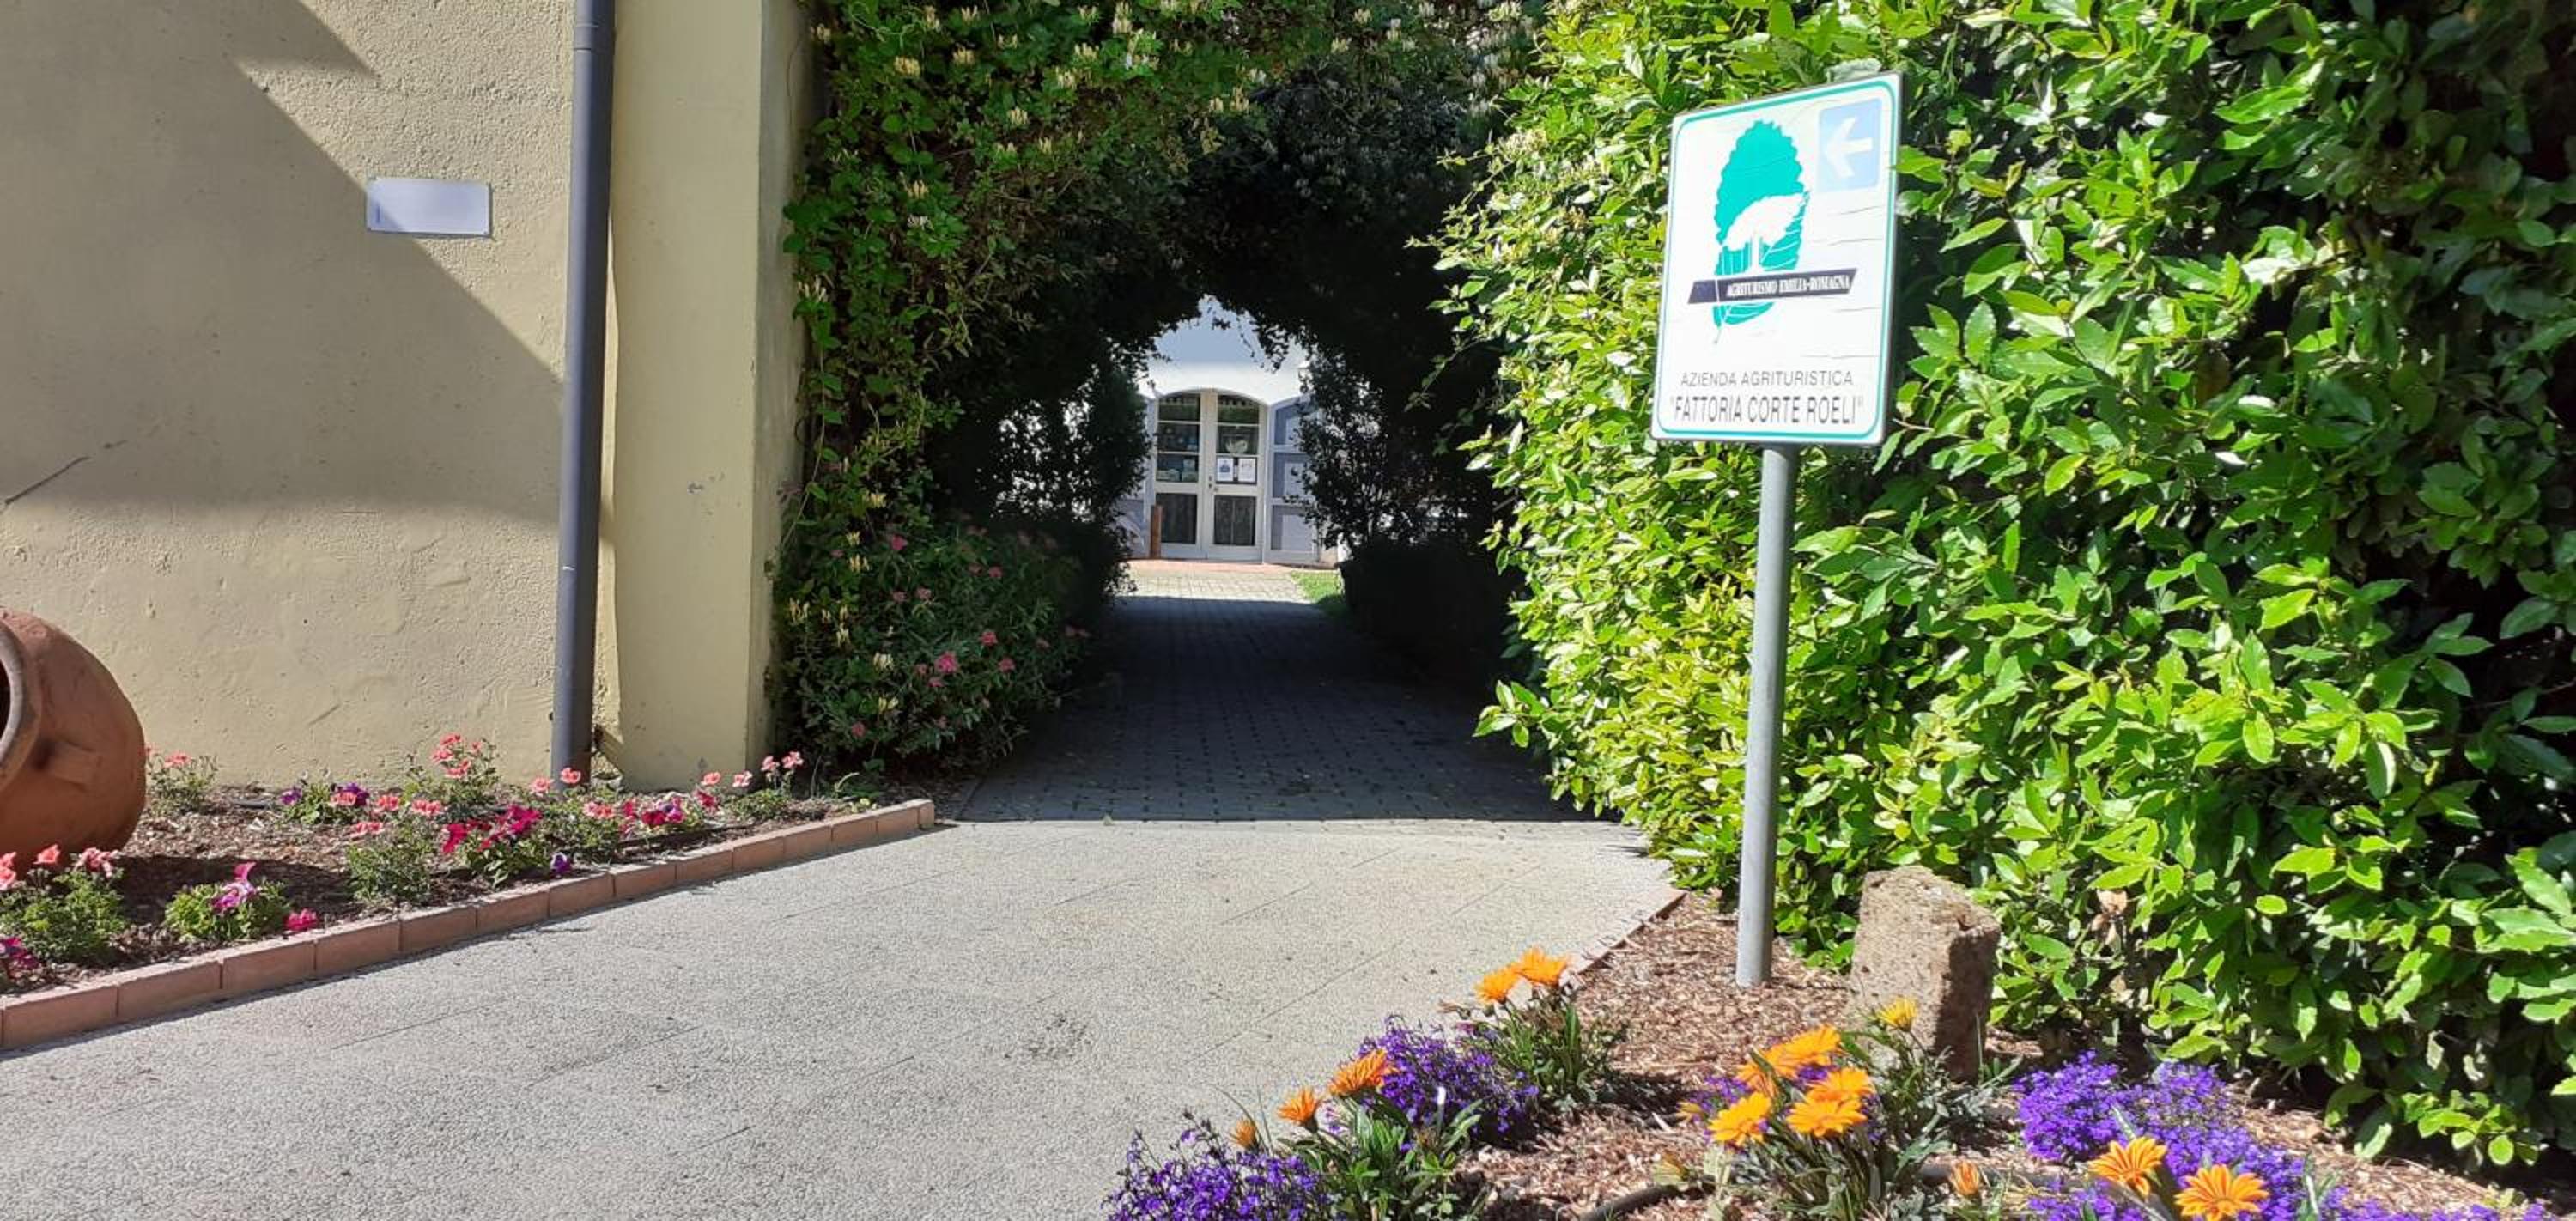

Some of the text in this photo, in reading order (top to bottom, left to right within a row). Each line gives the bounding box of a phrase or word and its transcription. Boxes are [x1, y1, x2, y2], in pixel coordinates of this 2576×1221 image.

[1727, 280, 1778, 296] AGRITURISMO
[1680, 370, 1853, 386] AZIENDA AGRITURISTICA
[1670, 395, 1863, 423] "FATTORIA CORTE ROELI"
